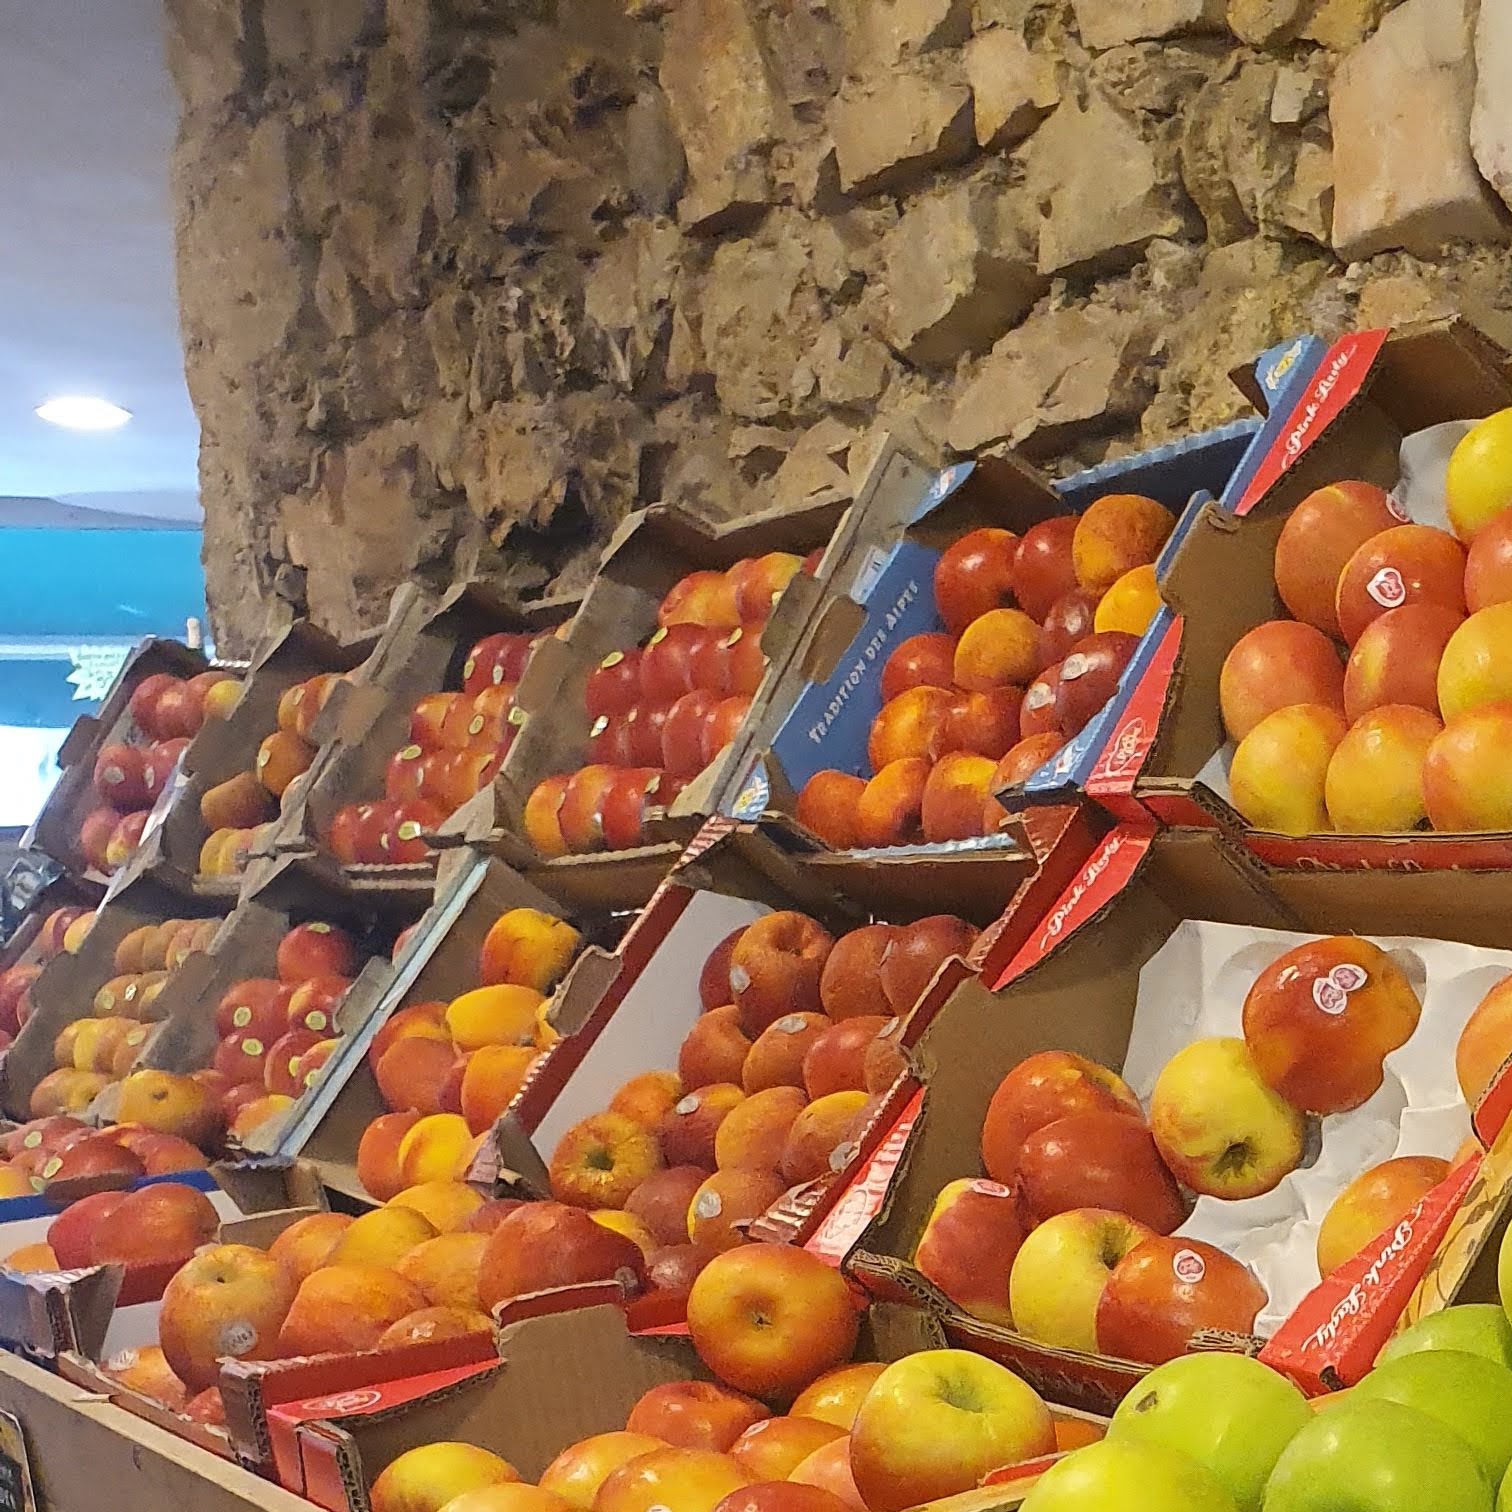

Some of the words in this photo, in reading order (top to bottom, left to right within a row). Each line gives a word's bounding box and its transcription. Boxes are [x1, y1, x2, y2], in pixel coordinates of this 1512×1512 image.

[807, 658, 868, 744] TRADITION
[1040, 884, 1085, 950] Pink
[1362, 1203, 1424, 1287] Pink
[1301, 1284, 1367, 1352] Lady
